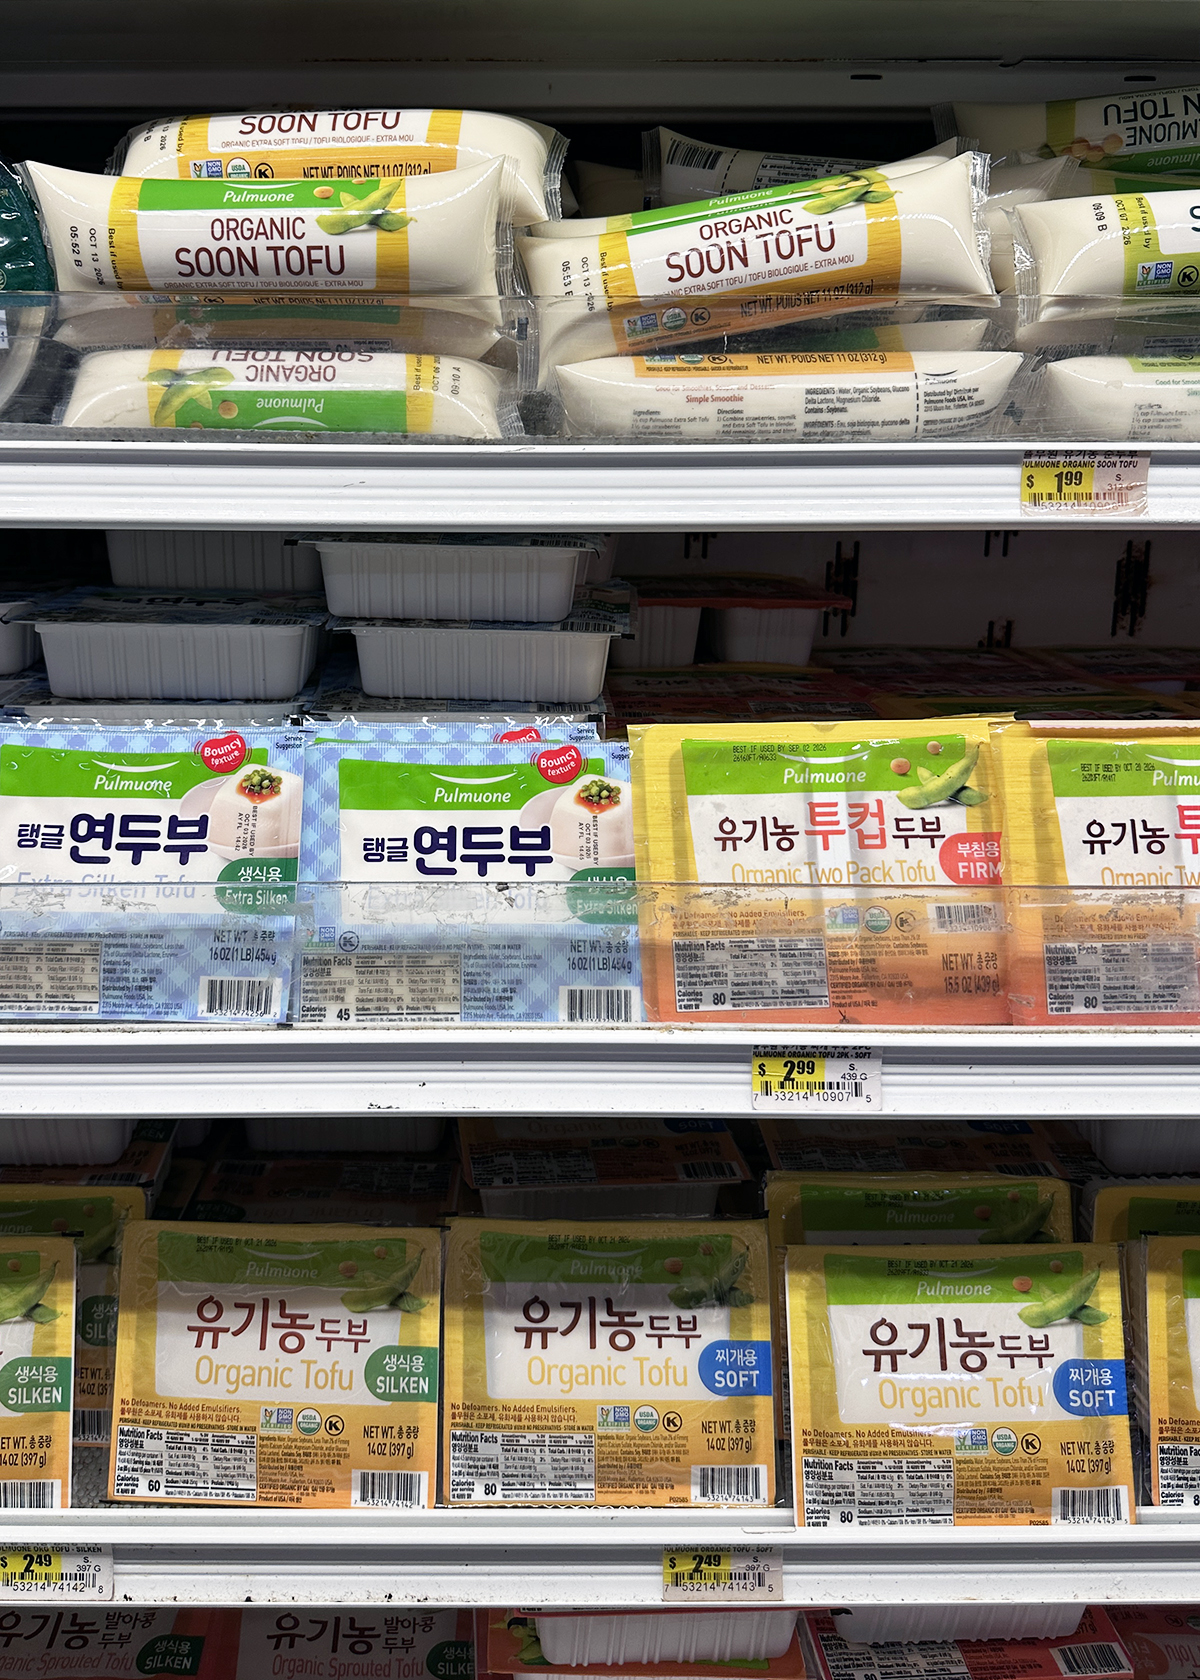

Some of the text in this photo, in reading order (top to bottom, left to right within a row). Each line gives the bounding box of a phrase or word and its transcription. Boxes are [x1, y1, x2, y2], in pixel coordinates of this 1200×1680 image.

[1103, 99, 1175, 126] TOFU
[238, 111, 401, 135] SOON TOFU
[231, 164, 245, 172] USDA
[223, 191, 294, 203] Pulmuone
[708, 189, 773, 207] Pulmuone
[698, 208, 794, 241] ORGANIC
[1092, 202, 1108, 232] 09:09 B
[211, 217, 305, 241] ORGANIC
[70, 226, 80, 255] 05:52
[89, 228, 105, 285] OCT 13 2026
[108, 228, 116, 249] Best
[112, 261, 121, 279] used
[175, 245, 345, 277] SOON TOFU
[664, 223, 836, 283] SOON TOFU
[279, 280, 319, 288] BIOLOGIQUE
[757, 352, 888, 365] NET WT. POIDS NET 11 OZ (312 g)
[245, 364, 337, 383] ORGANIC
[450, 374, 460, 395] 09:10
[256, 398, 324, 413] Pulmuone
[685, 394, 744, 403] Simple Smoothie
[1119, 460, 1138, 468] TOFU
[1026, 474, 1034, 489] $
[203, 737, 242, 758] Bouncy
[750, 745, 757, 753] IF
[760, 745, 774, 753] USED
[789, 744, 799, 752] SEP
[210, 749, 241, 766] texture
[540, 749, 578, 768] Bouncy
[547, 760, 577, 776] texture
[784, 769, 867, 784] Pulmuone
[94, 776, 172, 792] Pulmuone
[434, 788, 512, 804] Pulmuone
[713, 798, 946, 853] 유기농 투컵 두부
[17, 813, 209, 866] 탱글 연두부
[362, 825, 554, 877] 탱글 연두부
[957, 842, 1001, 858] 부침용
[237, 867, 283, 882] 생식용
[731, 860, 936, 884] Organic Two Pack Tofu
[958, 862, 1003, 879] FIRM
[712, 993, 726, 1006] 80
[336, 1008, 350, 1021] 45
[758, 1063, 766, 1077] $
[245, 1262, 319, 1278] Pulmuone
[917, 1281, 992, 1297] Pulmuone
[187, 1294, 371, 1354] 유기농 두부
[514, 1295, 702, 1352] 유기농 두부
[862, 1317, 1054, 1373] 유기농 두부
[383, 1354, 425, 1372] 생식용
[715, 1348, 758, 1367] 찌개용
[195, 1355, 354, 1394] Organic Tofu
[527, 1356, 688, 1394] Organic Tofu
[714, 1369, 759, 1388] SOFT
[1068, 1367, 1113, 1387] 찌개용
[376, 1376, 429, 1394] SILKEN
[878, 1377, 1044, 1417] Organic Tofu
[1069, 1389, 1115, 1408] SOFT
[131, 1399, 167, 1409] Defoamers.
[169, 1402, 178, 1410] No
[179, 1402, 199, 1411] Added
[200, 1404, 242, 1414] Emulsifiers.
[148, 1479, 161, 1492] 60
[484, 1483, 497, 1496] 80
[839, 1511, 853, 1524] 80
[1, 1556, 7, 1569] $
[669, 1557, 676, 1569] $
[682, 1582, 715, 1591] 53214
[722, 1582, 755, 1591] 74143
[106, 1611, 154, 1629] 발아콩
[384, 1616, 436, 1634] 발아콩
[40, 1652, 133, 1670] Sprouted Tofu
[144, 1655, 192, 1670] SILKEN
[273, 1655, 425, 1678] Organic Sprouted Tofu
